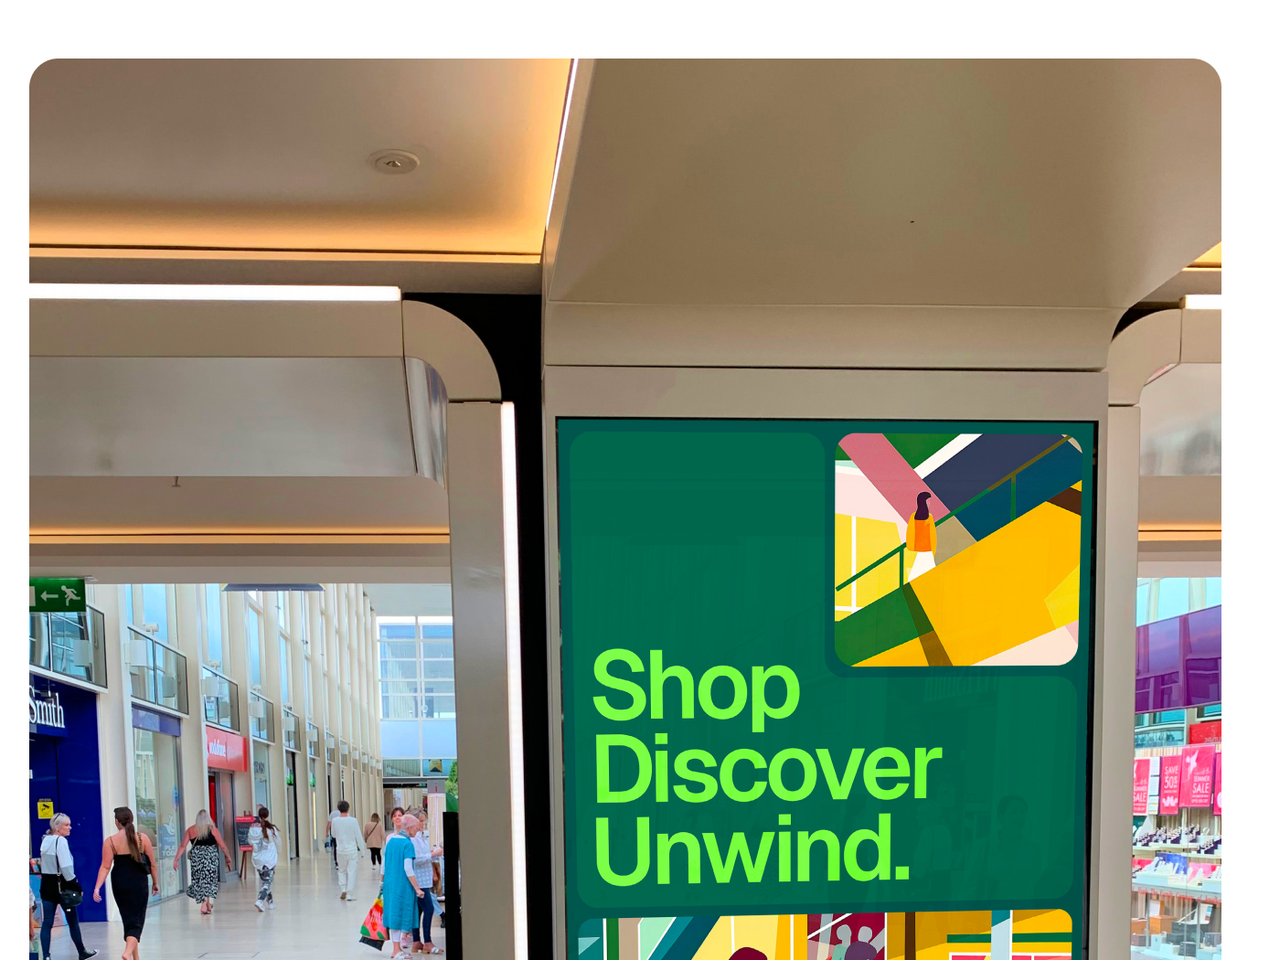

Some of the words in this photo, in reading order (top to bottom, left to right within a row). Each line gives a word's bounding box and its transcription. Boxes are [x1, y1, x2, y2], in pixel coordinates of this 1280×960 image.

[593, 648, 800, 733] Shop
[595, 733, 943, 803] Discover
[1164, 766, 1178, 774] SAVE
[1192, 783, 1209, 793] SALE
[595, 813, 910, 886] Unwind.
